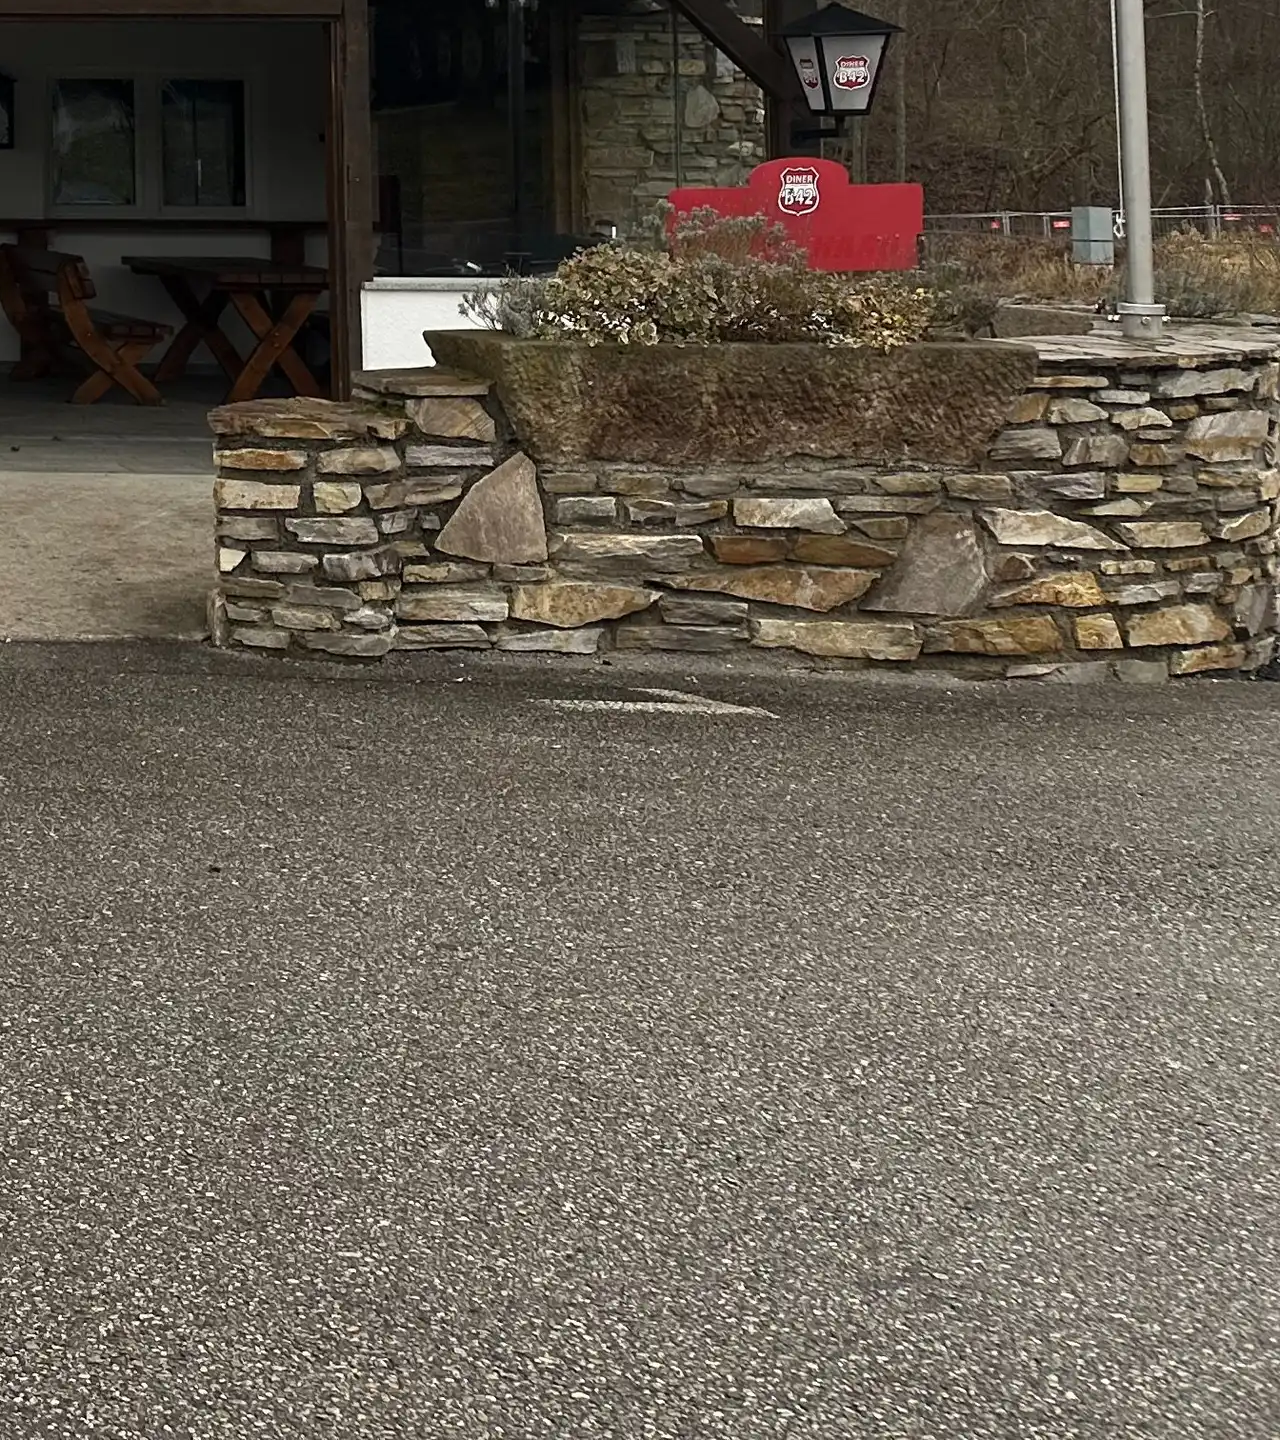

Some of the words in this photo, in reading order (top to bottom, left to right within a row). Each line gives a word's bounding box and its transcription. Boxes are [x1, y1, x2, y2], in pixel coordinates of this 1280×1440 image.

[839, 70, 865, 83] B42
[785, 174, 813, 184] DINER
[783, 188, 814, 206] B42
